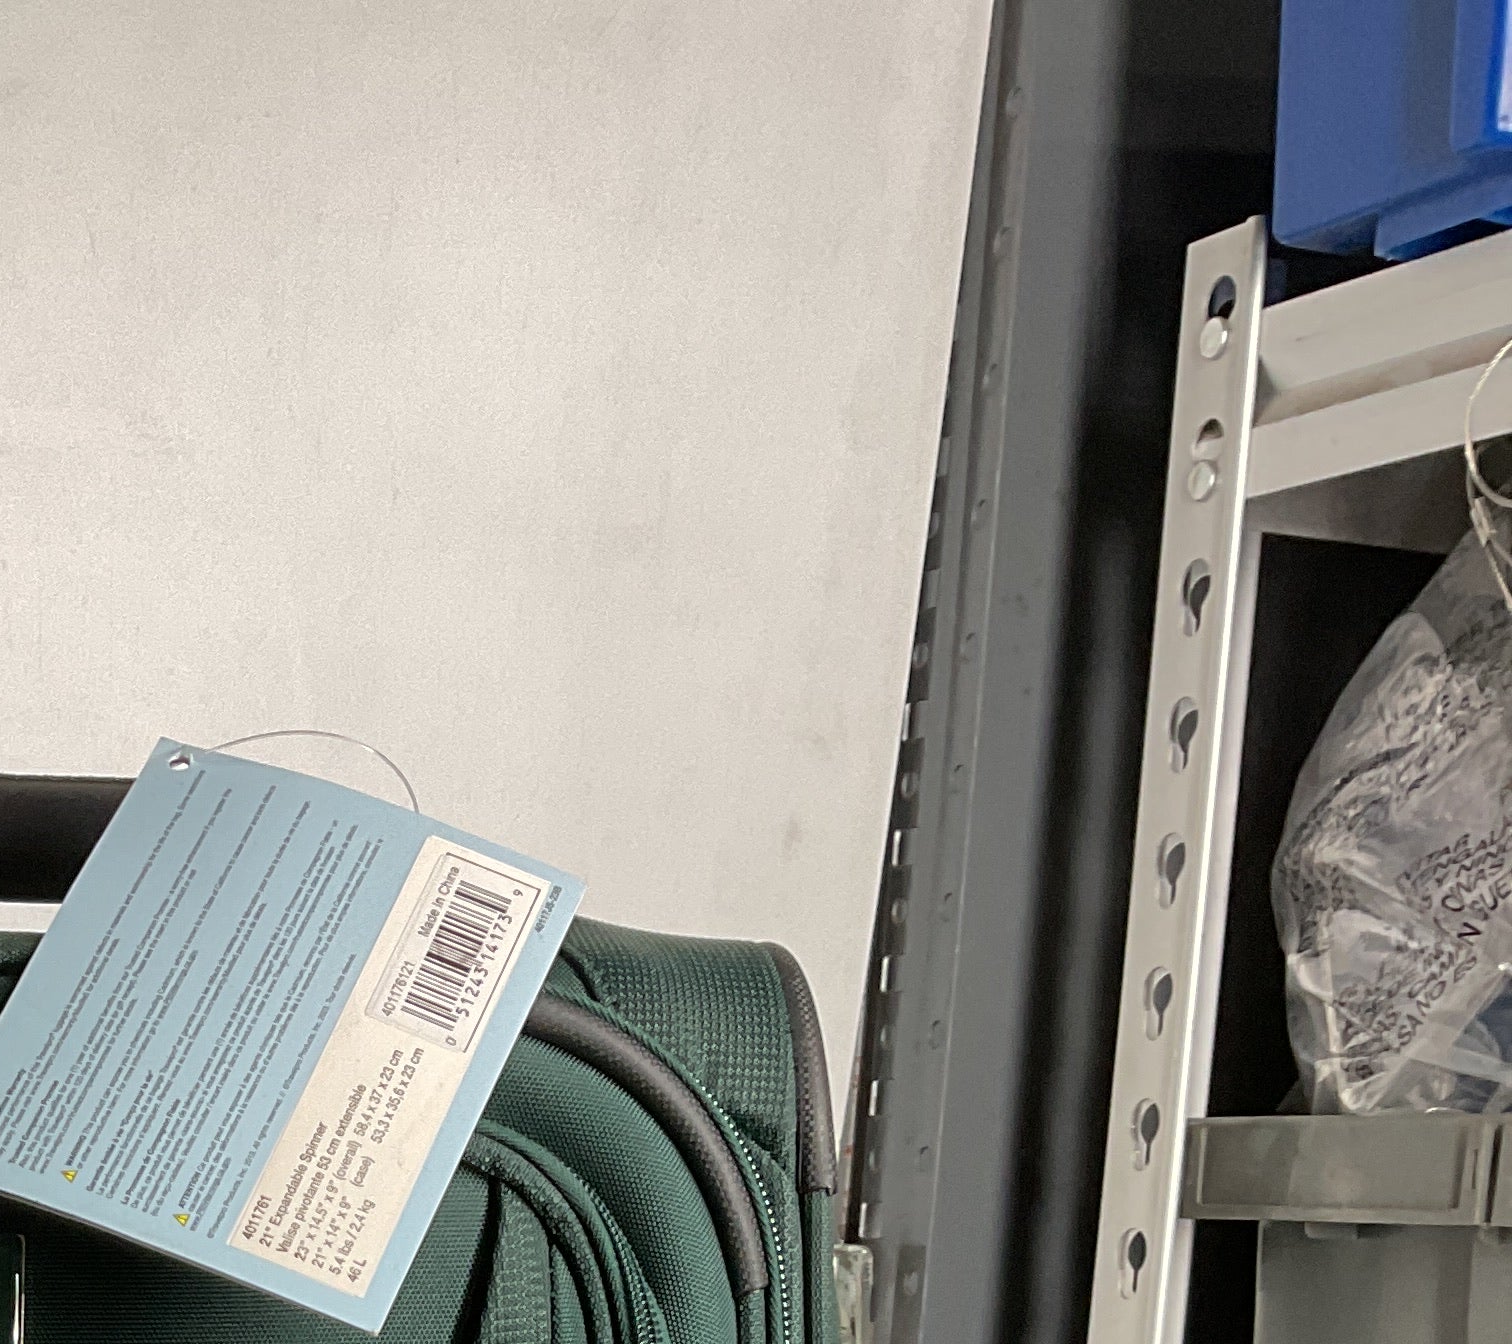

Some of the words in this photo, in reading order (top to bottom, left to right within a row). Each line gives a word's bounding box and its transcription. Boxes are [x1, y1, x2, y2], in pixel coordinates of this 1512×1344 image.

[436, 864, 461, 896] China
[431, 895, 446, 907] in
[416, 907, 441, 937] Made
[378, 959, 417, 1017] 401176121
[444, 1035, 458, 1046] 0
[387, 1049, 403, 1067] cm
[409, 1047, 424, 1065] cm
[379, 1065, 395, 1081] 23
[400, 1063, 416, 1079] 23
[377, 1081, 388, 1090] x
[398, 1079, 409, 1087] x
[368, 1088, 384, 1105] 37
[385, 1086, 407, 1112] 35,6
[331, 1082, 367, 1137] extensible
[365, 1105, 377, 1113] x
[383, 1111, 394, 1120] x
[352, 1112, 375, 1138] 58,4
[369, 1119, 392, 1145] 53,3
[324, 1137, 341, 1156] cm
[316, 1155, 332, 1170] 53
[332, 1139, 362, 1181] (overall)
[268, 1162, 309, 1226] Expandable
[298, 1120, 329, 1163] Spinner
[349, 1154, 376, 1188] (case)
[291, 1170, 326, 1222] pivotante
[323, 1194, 334, 1202] x
[336, 1210, 347, 1219] x
[356, 1197, 376, 1214] kg
[240, 1194, 272, 1240] 4011761
[348, 1212, 368, 1233] 2,4
[275, 1220, 301, 1254] Valise
[305, 1232, 316, 1240] x
[323, 1239, 334, 1248] x
[336, 1237, 354, 1255] lbs
[328, 1255, 346, 1275] 5.4
[352, 1256, 366, 1266] L
[345, 1265, 363, 1283] 46
